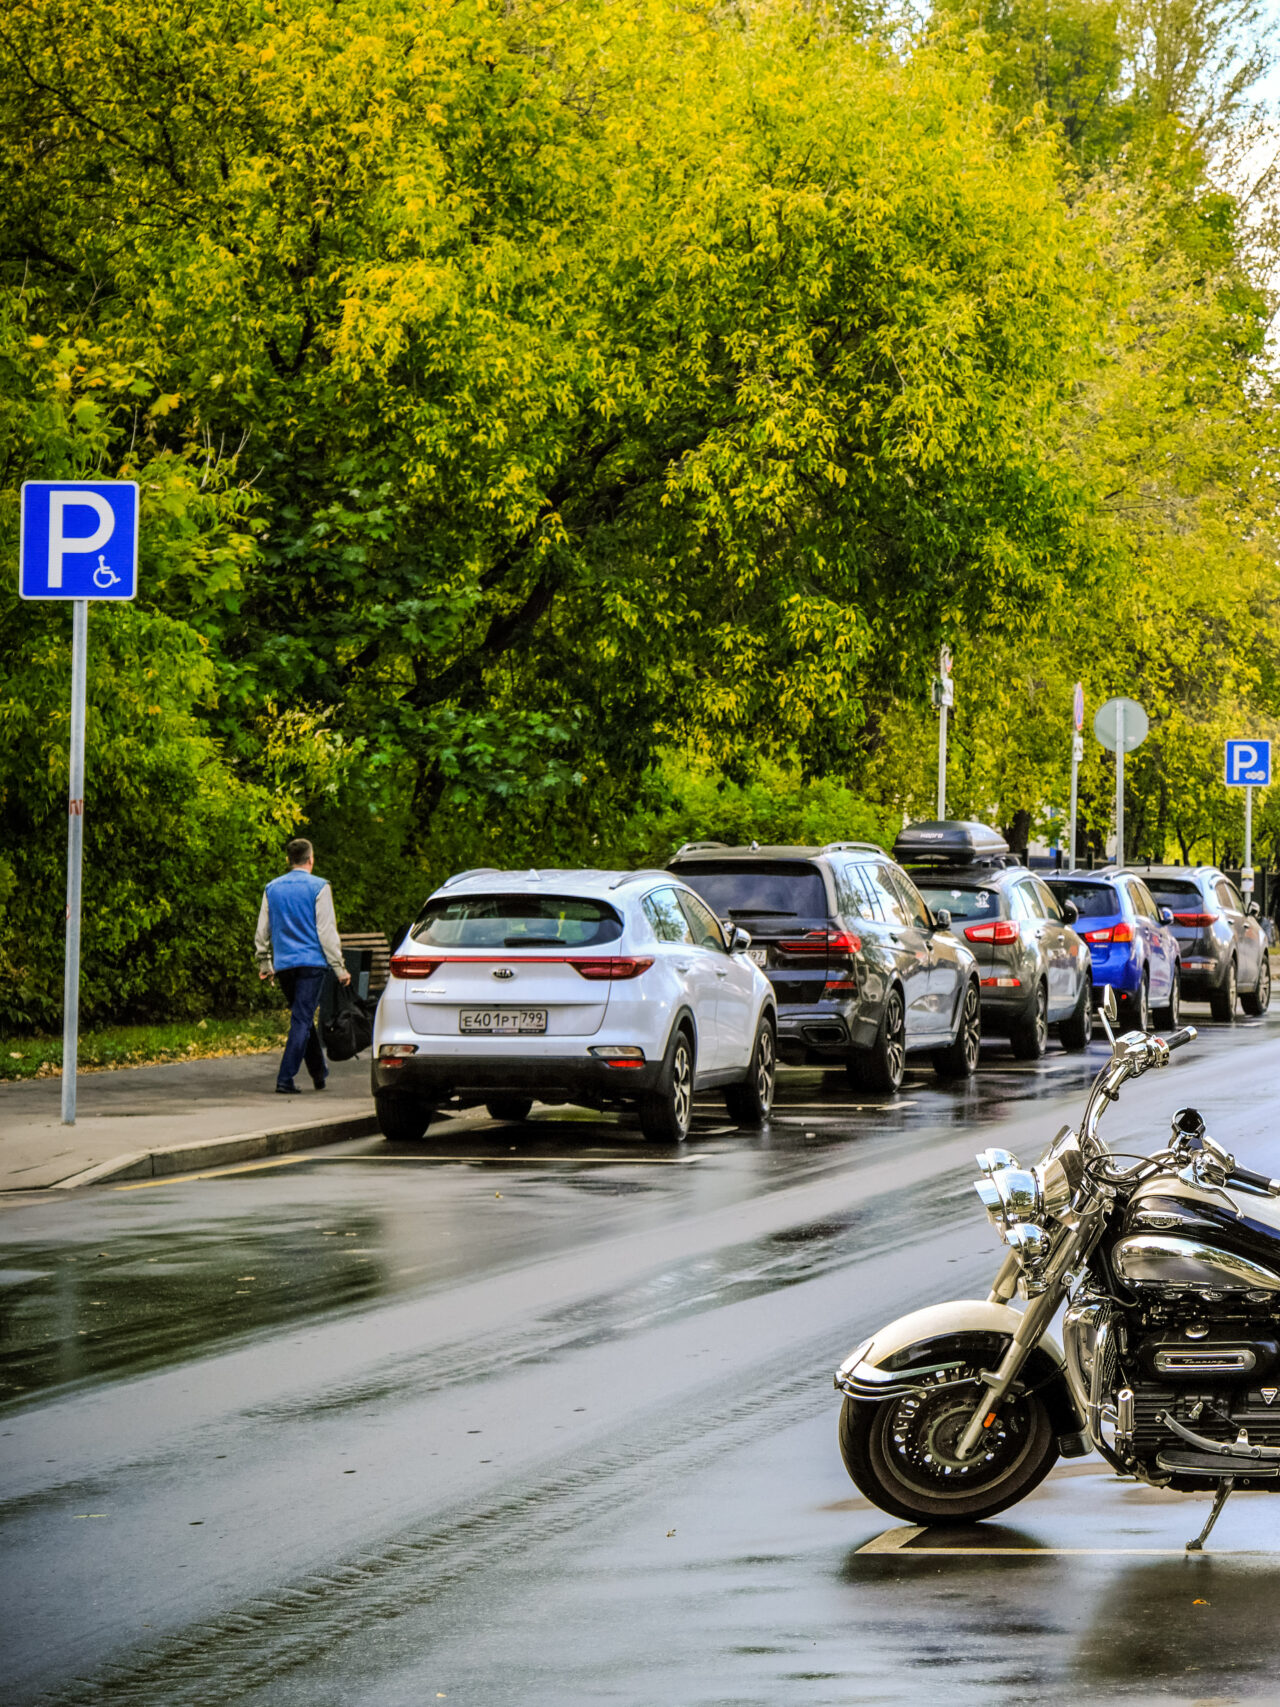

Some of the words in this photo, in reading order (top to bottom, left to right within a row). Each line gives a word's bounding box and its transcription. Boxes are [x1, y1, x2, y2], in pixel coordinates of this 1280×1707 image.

[47, 490, 116, 588] P
[1233, 744, 1258, 781] P
[464, 1013, 519, 1027] Е401РТ
[521, 1012, 543, 1024] 799
